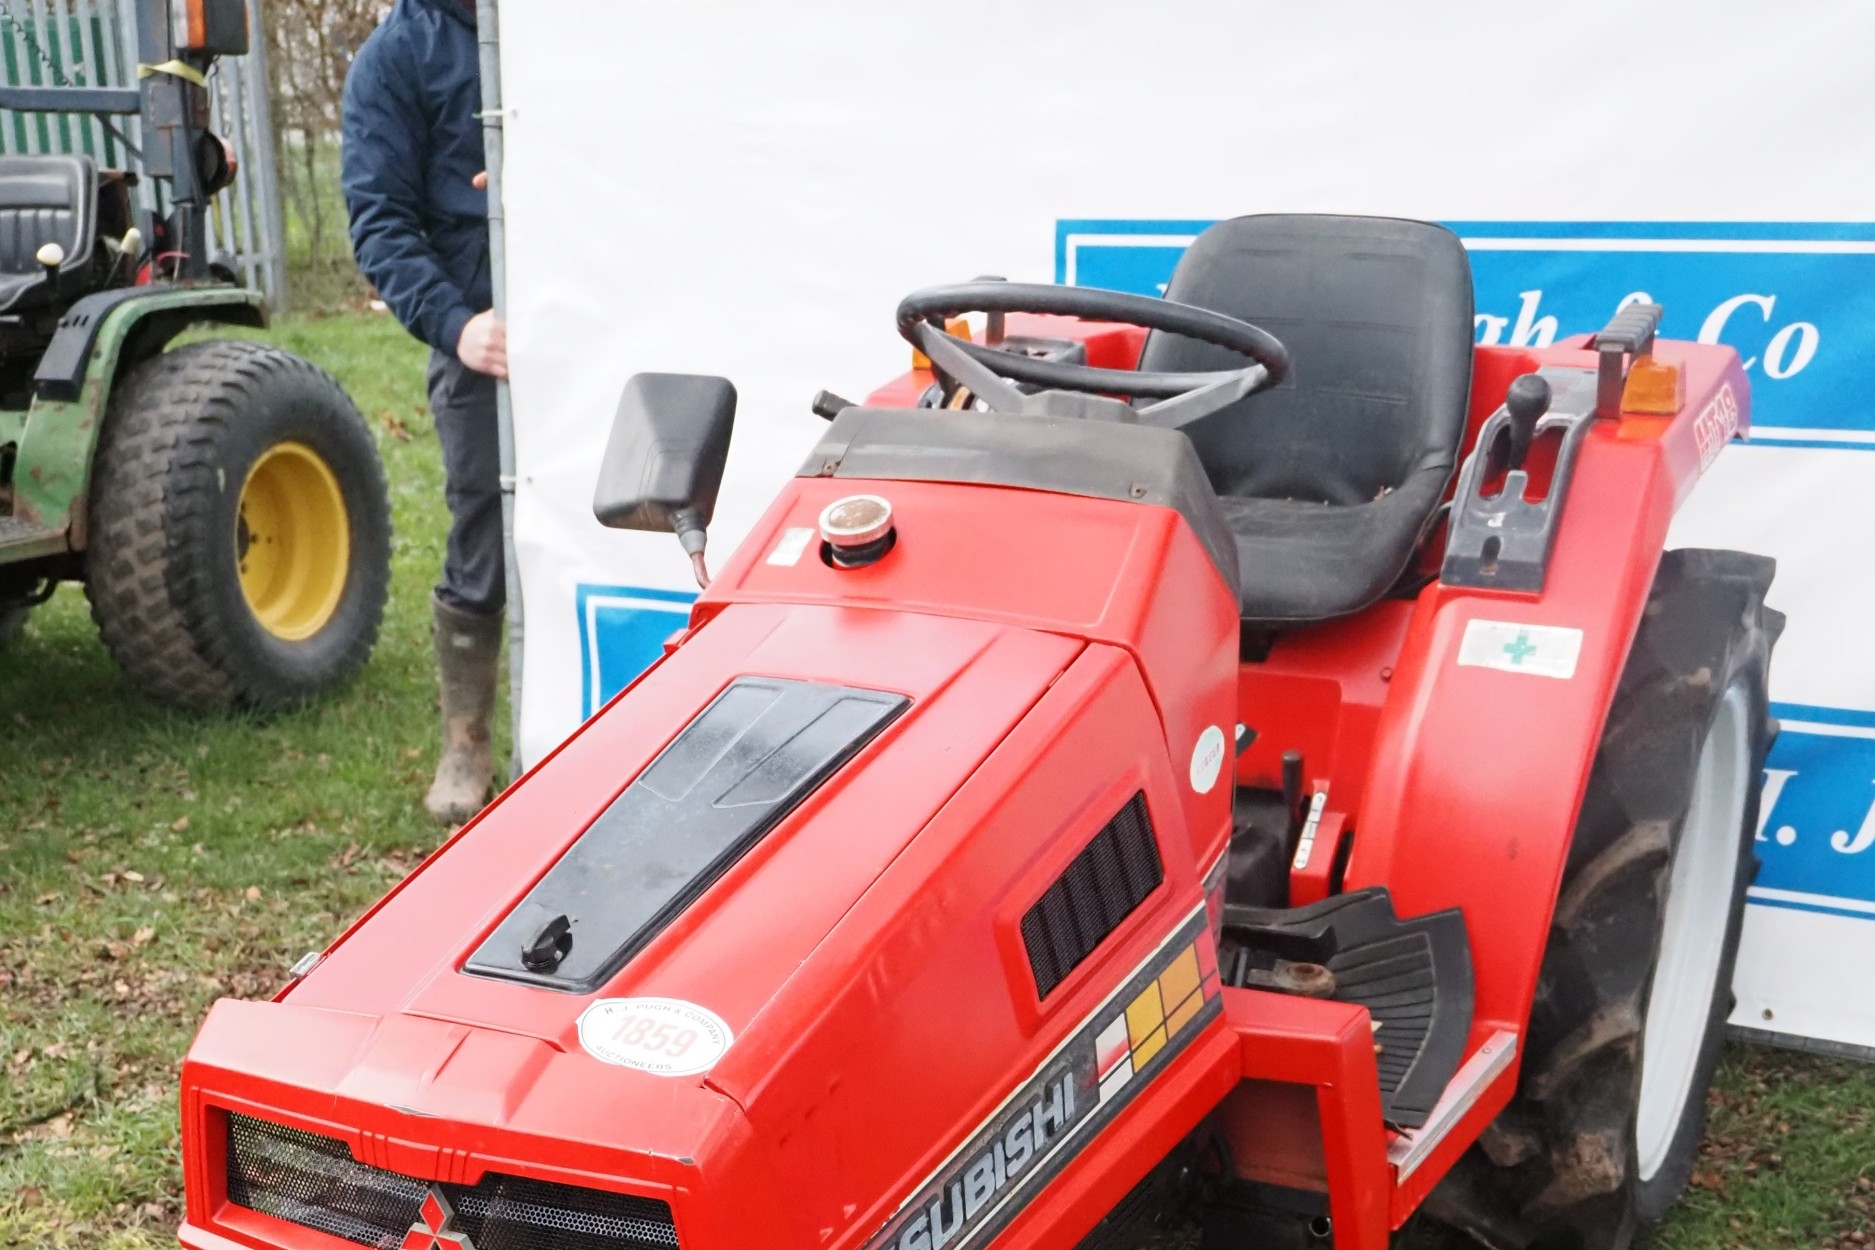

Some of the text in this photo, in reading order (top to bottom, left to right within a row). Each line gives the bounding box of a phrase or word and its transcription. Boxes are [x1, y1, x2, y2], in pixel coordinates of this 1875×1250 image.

[1698, 294, 1820, 380] Co
[611, 1014, 699, 1058] 1859
[636, 1004, 672, 1012] PUGH
[684, 1011, 721, 1045] COMPANY
[595, 1045, 673, 1071] AUCTIONEERS
